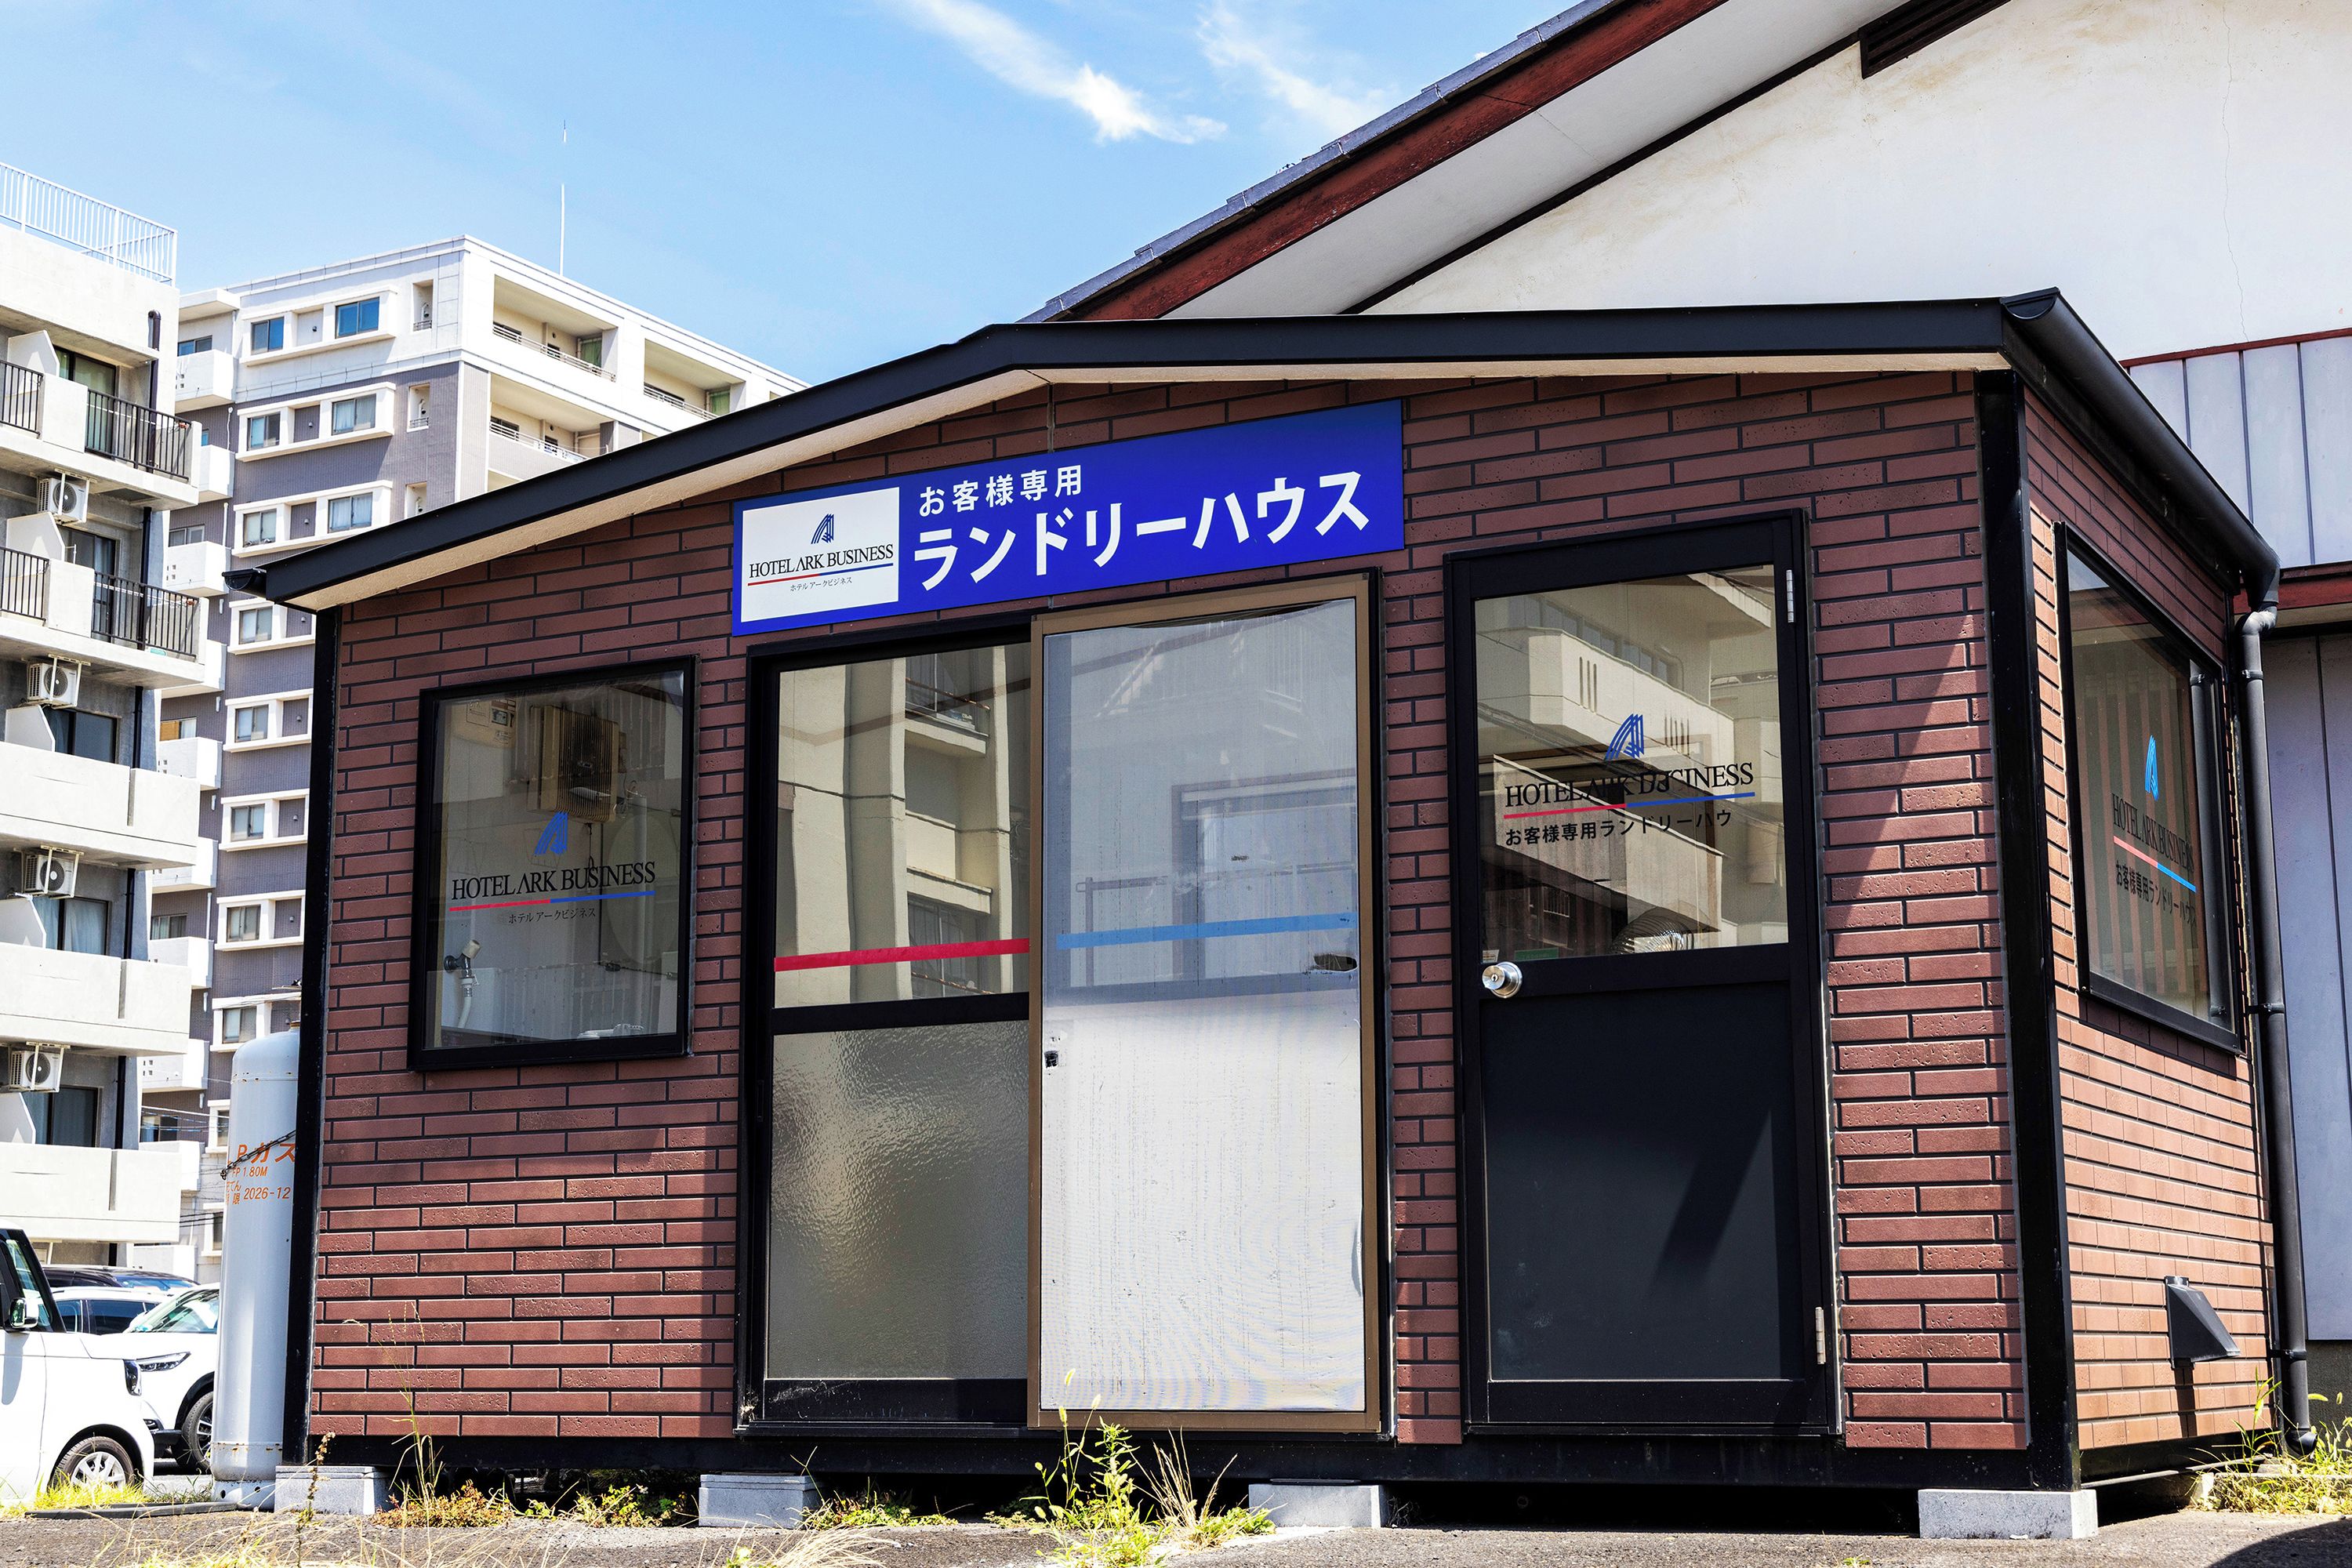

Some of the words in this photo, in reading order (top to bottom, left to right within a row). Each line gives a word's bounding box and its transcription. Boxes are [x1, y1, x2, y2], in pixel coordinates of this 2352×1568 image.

[919, 464, 1081, 517] お客様専用
[914, 470, 1370, 591] ランドリーハウス
[827, 543, 894, 568] BUSINESS
[561, 862, 656, 891] BUSINESS
[243, 1186, 292, 1200] 2026-12
